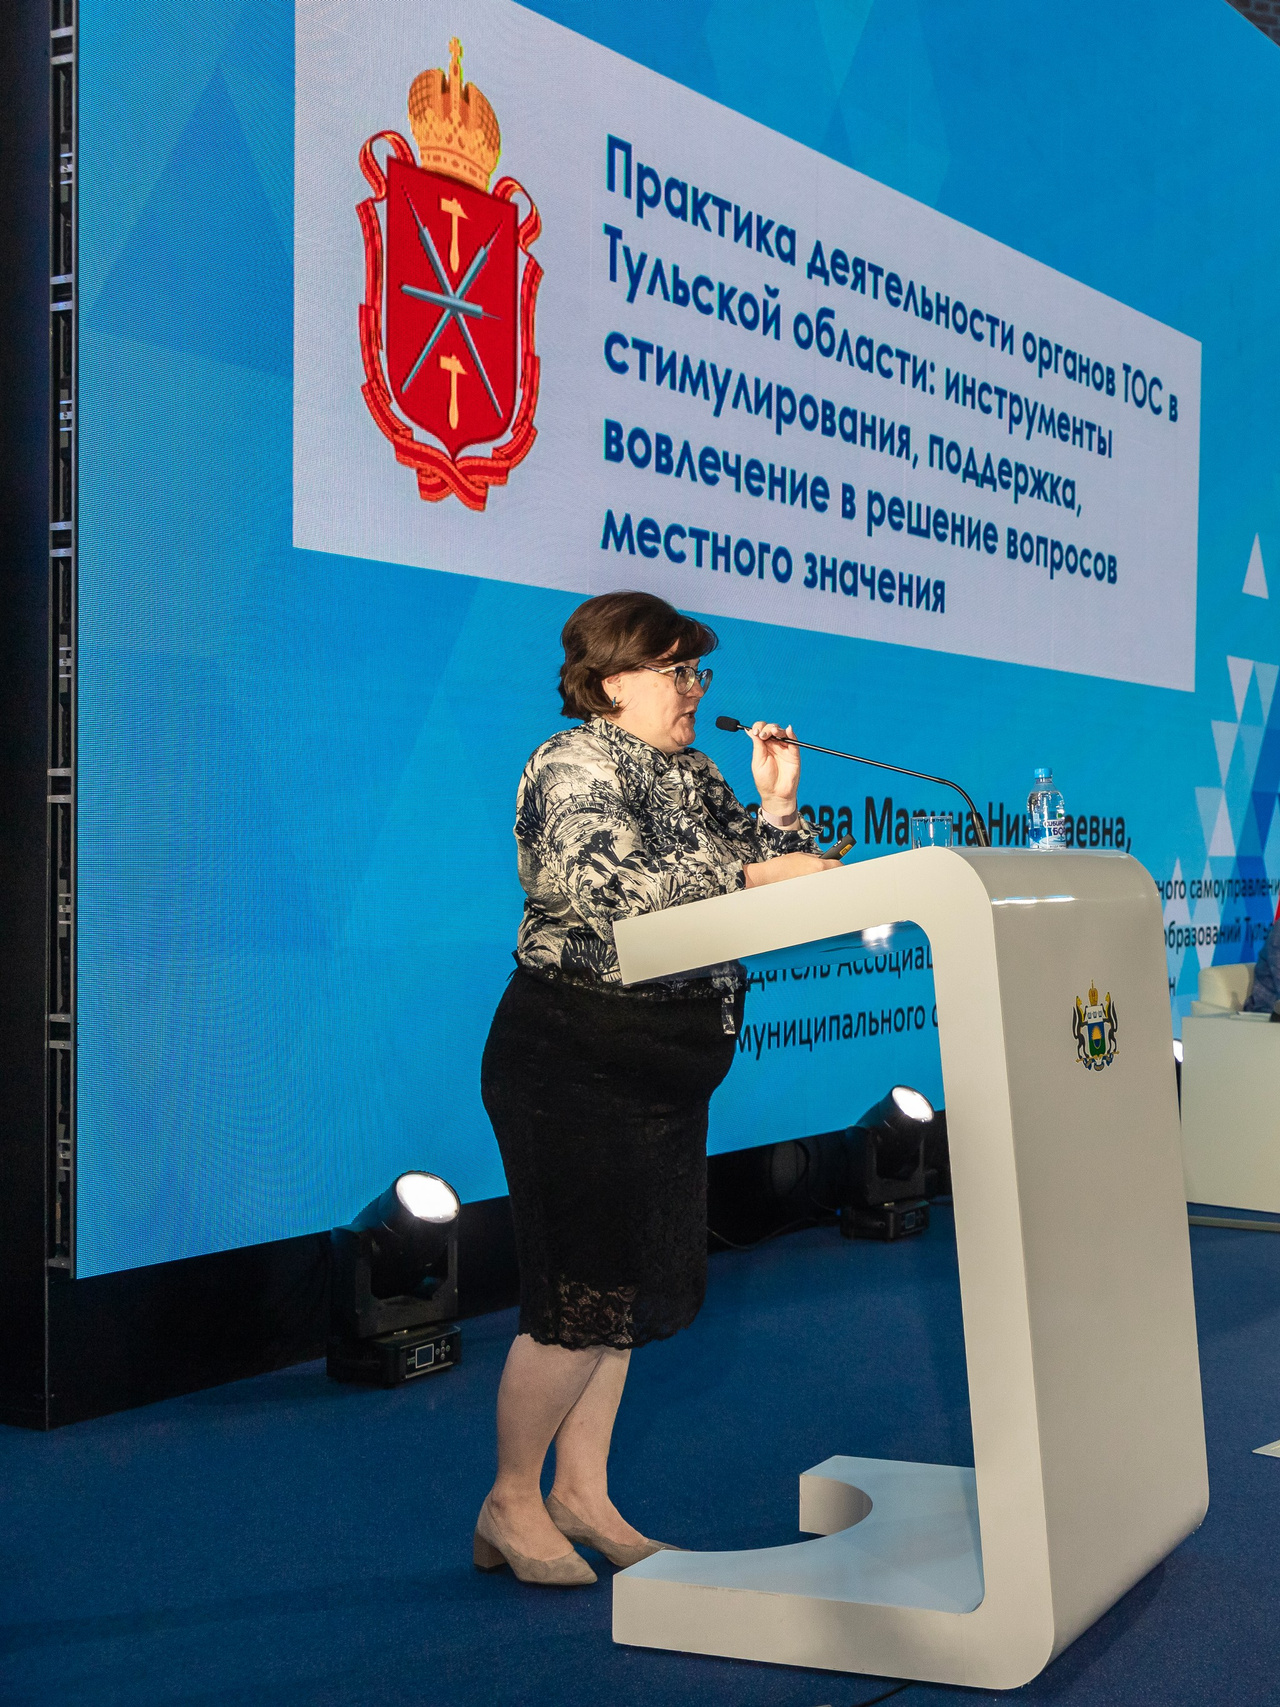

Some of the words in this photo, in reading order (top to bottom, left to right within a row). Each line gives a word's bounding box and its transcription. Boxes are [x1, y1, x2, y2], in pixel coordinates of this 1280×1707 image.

[603, 223, 781, 341] Тульской
[793, 307, 936, 395] области:
[945, 366, 1114, 459] инструменты
[606, 133, 797, 266] Практика
[806, 240, 1014, 357] деятельности
[1022, 331, 1116, 397] органов
[1122, 362, 1163, 416] ТОС
[1169, 393, 1179, 423] в
[603, 330, 918, 469] стимулирования,
[928, 434, 1083, 517] поддержка,
[603, 418, 830, 514] вовлечение
[841, 482, 857, 520] в
[867, 489, 998, 555] решение
[1006, 532, 1118, 585] вопросов
[600, 509, 793, 584] местного
[803, 551, 946, 614] значения
[737, 1005, 926, 1061] муниципального
